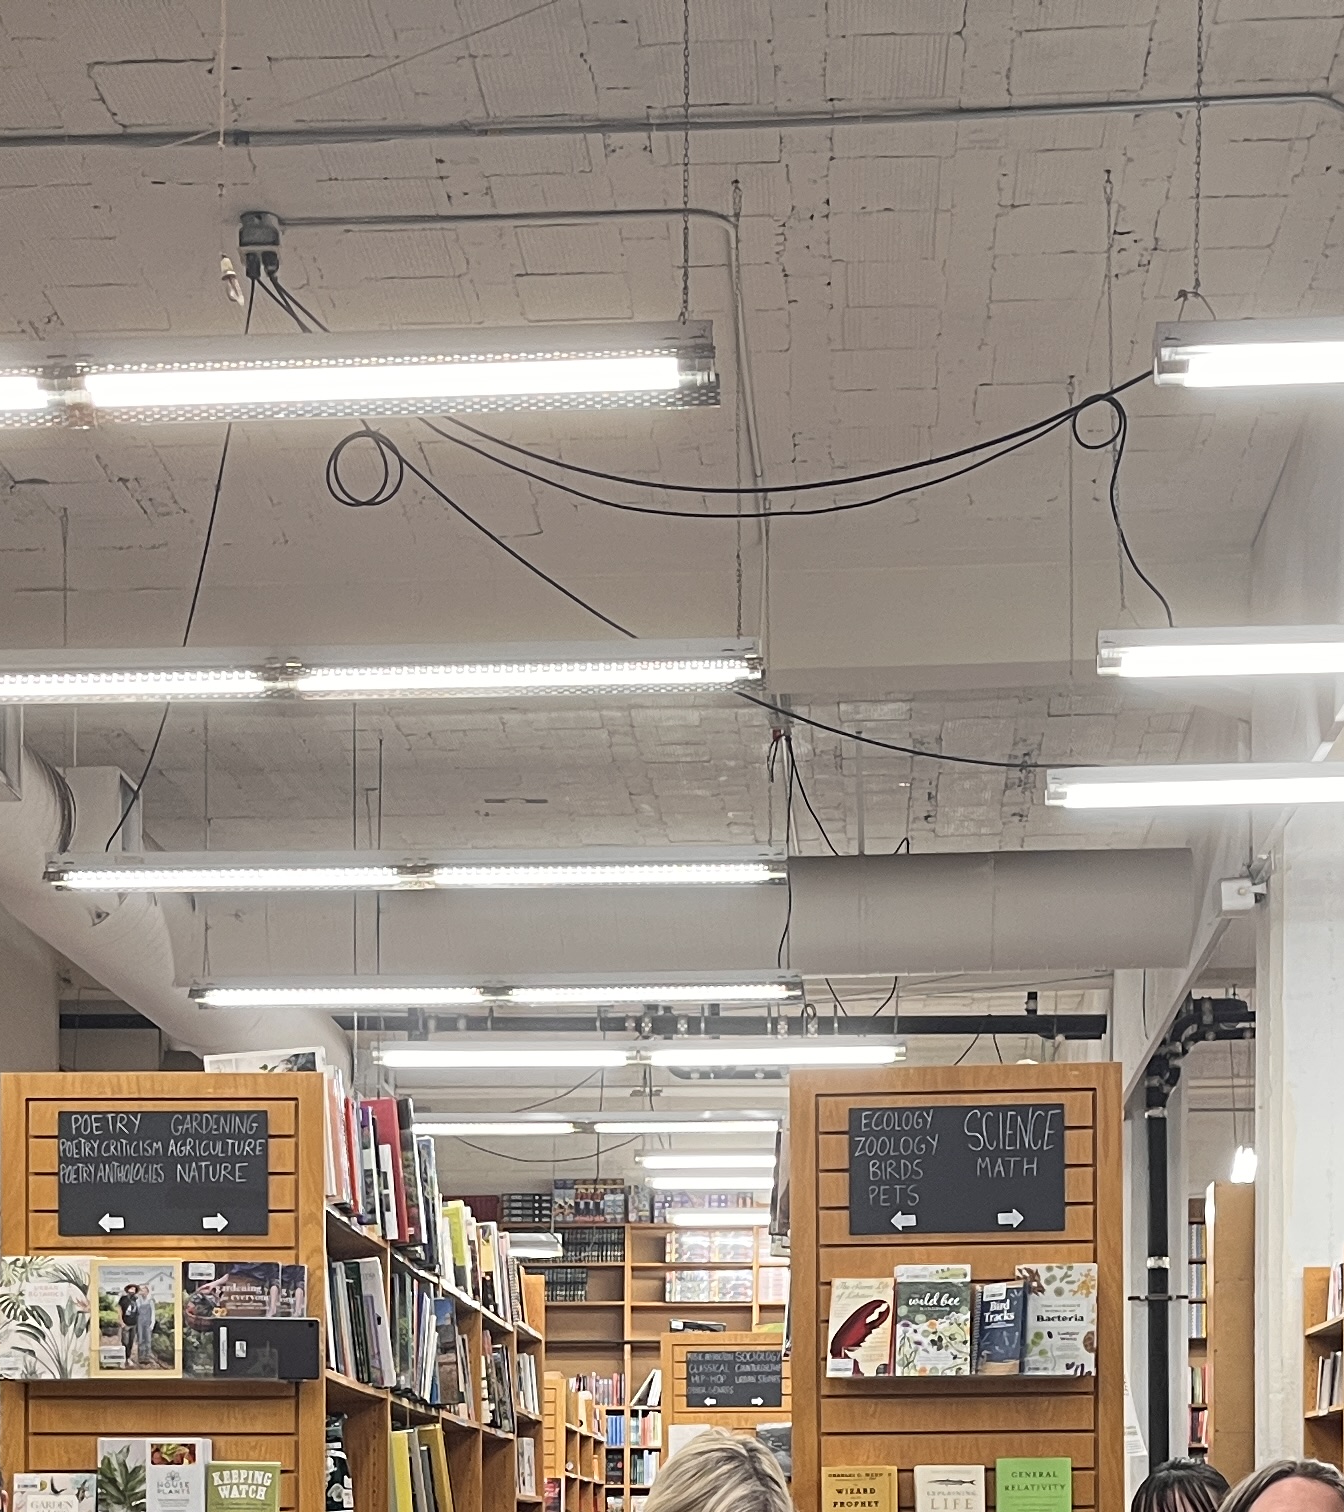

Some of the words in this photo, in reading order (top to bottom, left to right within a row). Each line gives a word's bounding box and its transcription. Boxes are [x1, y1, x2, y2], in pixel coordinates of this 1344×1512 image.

[71, 1113, 142, 1135] POETRY
[170, 1113, 260, 1135] GARDENING
[861, 1108, 934, 1132] ECOLOGY
[963, 1106, 1062, 1152] SCIENCE
[59, 1137, 100, 1159] POETRY
[101, 1137, 164, 1158] CRITICISM
[167, 1138, 267, 1158] AGRICULTURE
[853, 1134, 940, 1157] ZOOLOGY
[976, 1156, 1038, 1179] MATH
[59, 1161, 97, 1184] POETRY
[97, 1160, 165, 1185] ANTHOLOGIES
[176, 1161, 250, 1184] NATURE
[869, 1158, 925, 1181] BIRDS
[868, 1184, 920, 1207] PETS
[908, 1291, 938, 1307] wild
[941, 1292, 961, 1307] bee
[989, 1299, 1011, 1311] Bird
[983, 1311, 1016, 1323] Tracks
[1035, 1313, 1086, 1323] Bacteria
[735, 1351, 781, 1362] SOCIOLOGY
[689, 1363, 730, 1373] CLASSICAL
[690, 1374, 727, 1384] HIP-HOP
[211, 1469, 273, 1486] KEEPING
[1011, 1471, 1059, 1479] GENERAL
[156, 1480, 191, 1489] HOUSE
[1004, 1483, 1067, 1493] RELATIVITY
[217, 1485, 267, 1501] WATCH
[835, 1487, 877, 1496] WIZARD
[30, 1500, 74, 1511] GARDEN
[832, 1500, 881, 1509] PROPHET
[930, 1498, 975, 1511] LIFE
